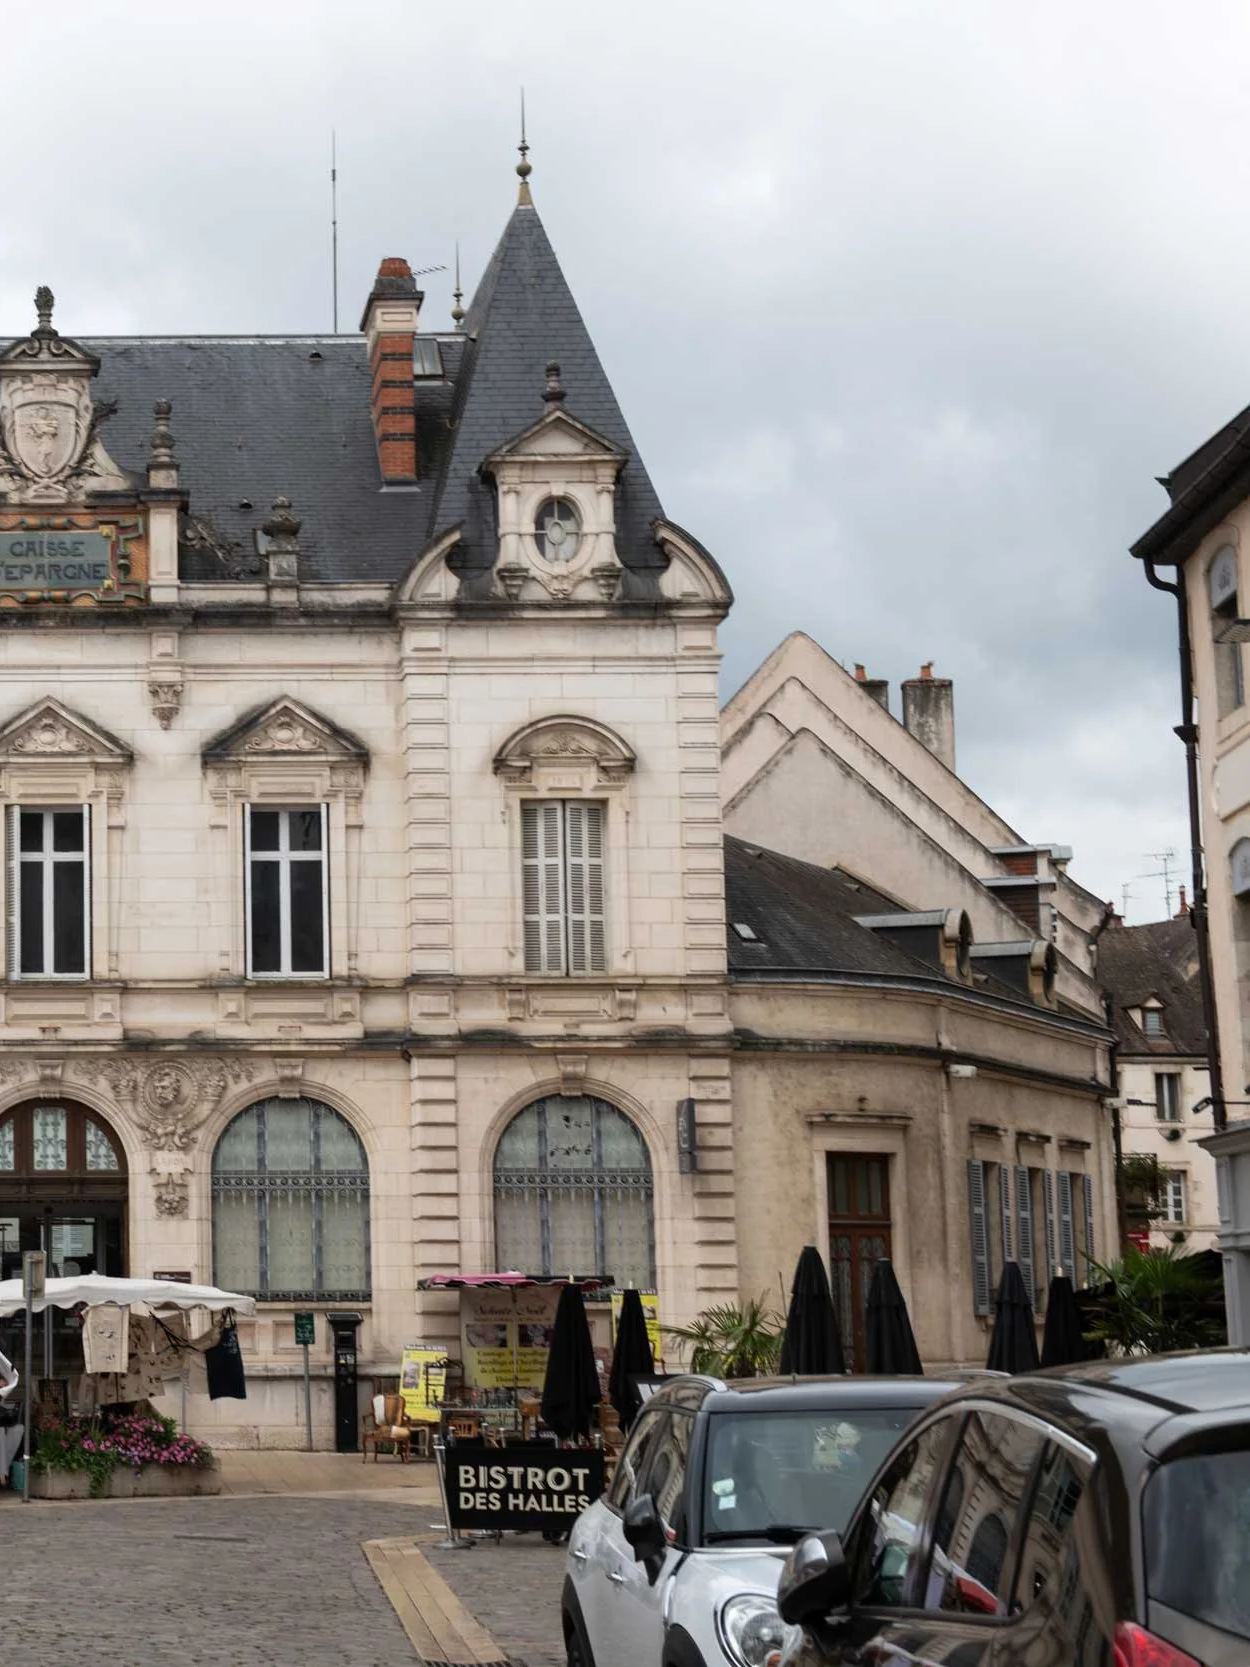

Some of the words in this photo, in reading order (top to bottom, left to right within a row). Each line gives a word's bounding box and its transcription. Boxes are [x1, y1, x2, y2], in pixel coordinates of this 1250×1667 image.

[9, 541, 84, 558] CAISSE
[458, 1465, 590, 1491] BISTROT
[459, 1492, 501, 1510] DES
[508, 1493, 590, 1512] HALLES
